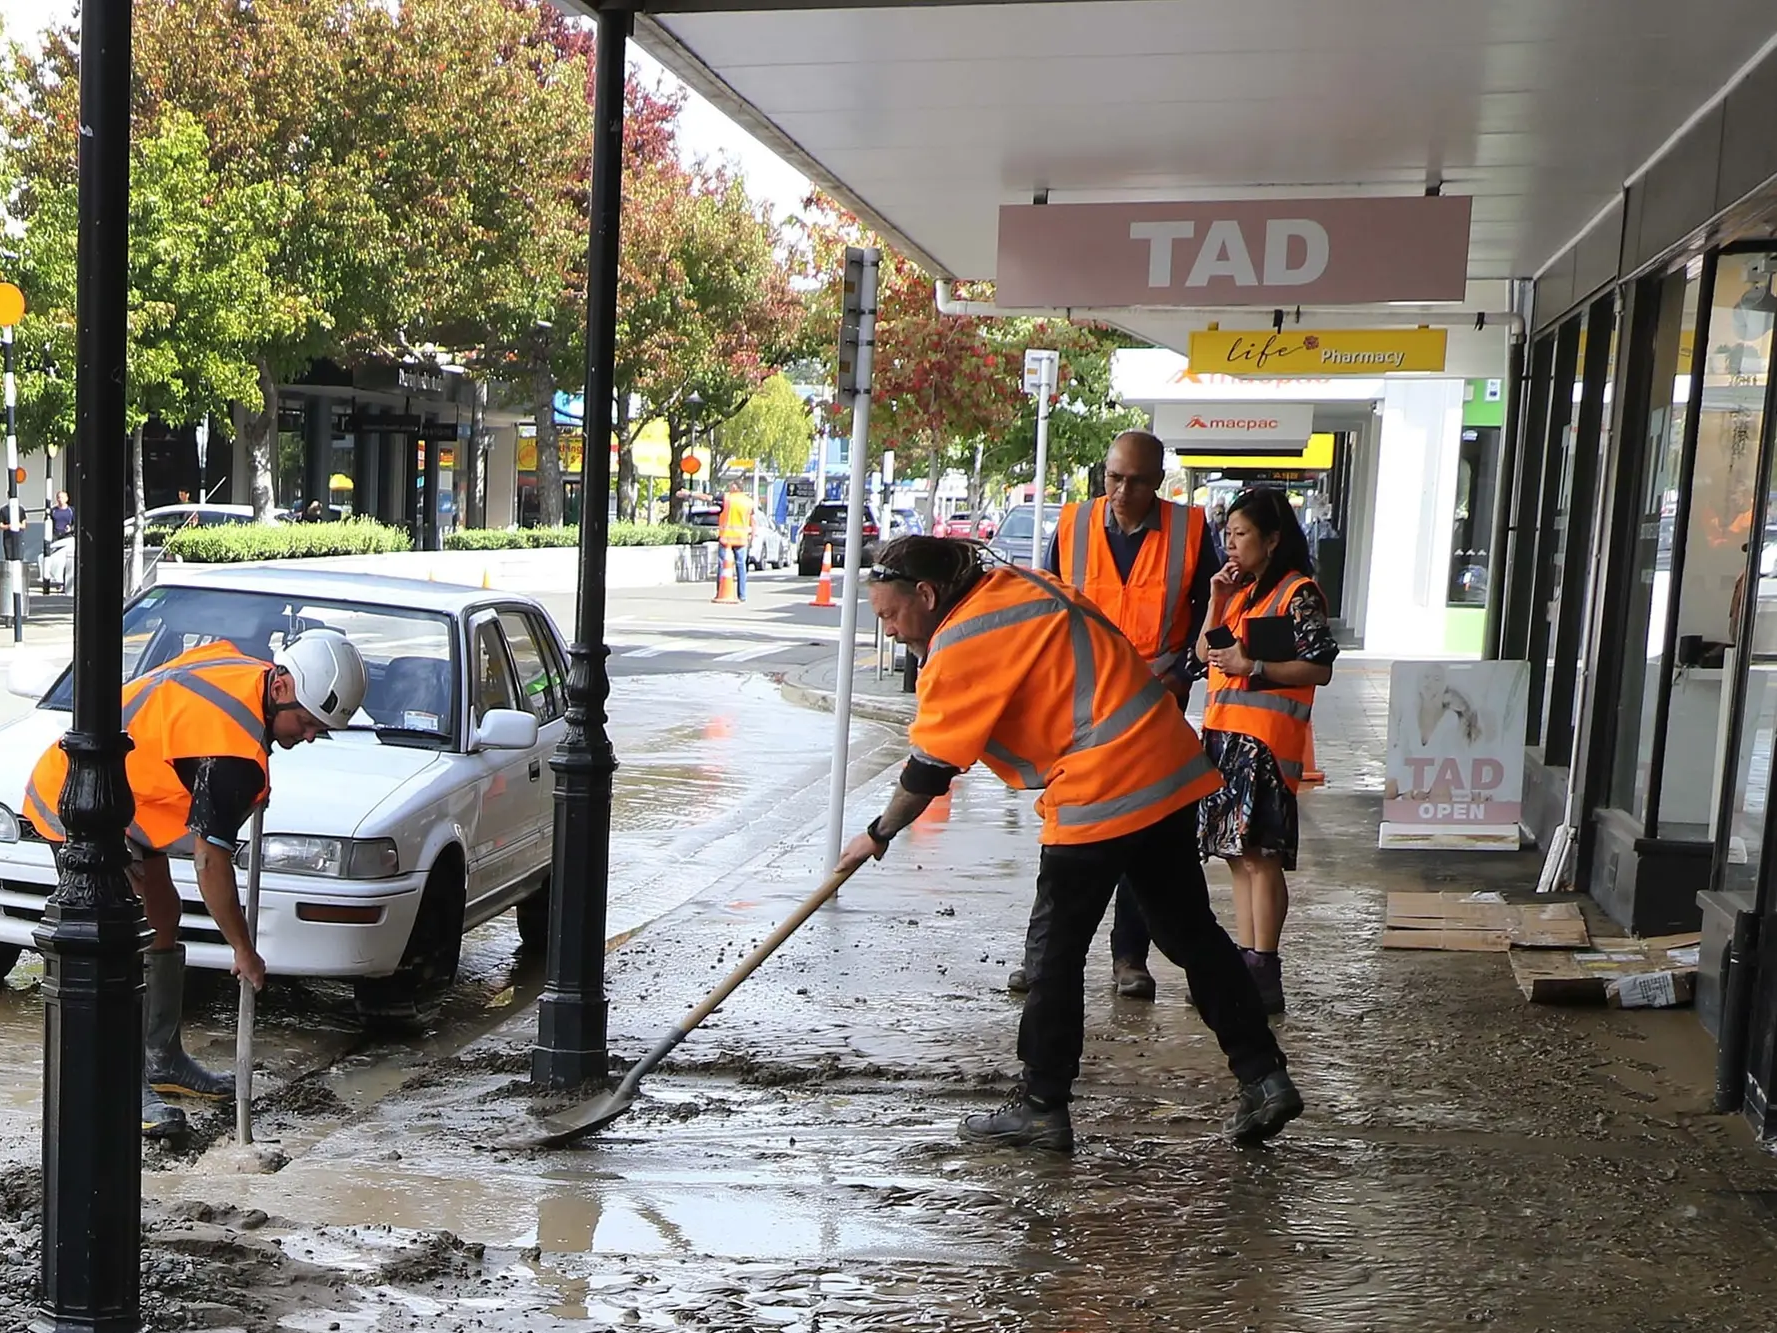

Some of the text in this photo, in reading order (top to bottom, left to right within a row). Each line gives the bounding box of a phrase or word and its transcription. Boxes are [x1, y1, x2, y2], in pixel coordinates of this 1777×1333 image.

[1129, 218, 1330, 288] TAD
[1226, 334, 1405, 369] life Pharmacy
[1210, 417, 1278, 431] macpac
[1404, 757, 1504, 791] TAD
[1418, 803, 1485, 819] OPEN
